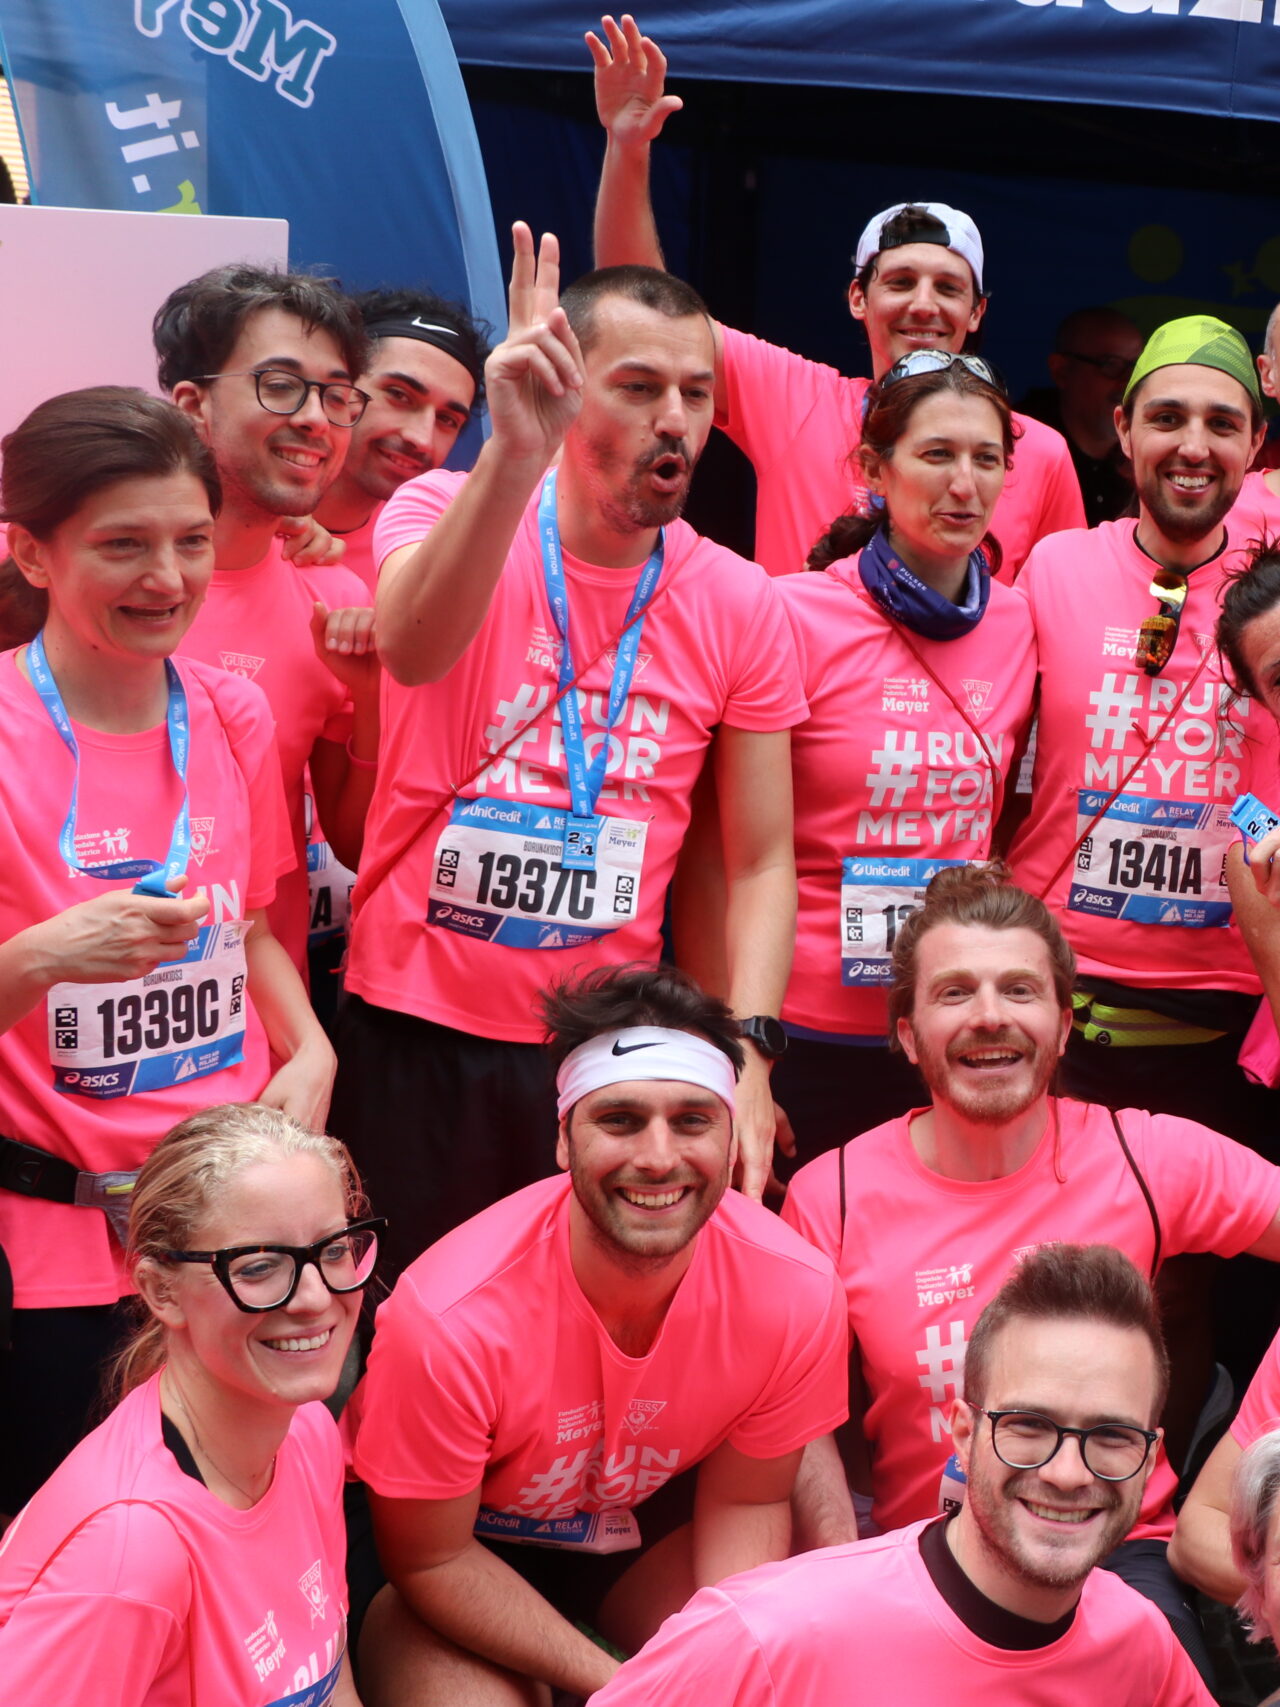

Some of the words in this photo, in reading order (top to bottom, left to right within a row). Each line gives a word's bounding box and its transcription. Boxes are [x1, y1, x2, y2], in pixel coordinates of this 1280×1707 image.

[639, 567, 656, 600] EDITION
[1102, 643, 1137, 660] Mey
[224, 655, 259, 670] GUESS
[882, 697, 930, 715] Meyer
[1148, 716, 1246, 758] FOR
[1084, 752, 1241, 798] MEYER
[470, 805, 522, 824] UniCredit
[1098, 797, 1141, 815] UiCredit
[1169, 806, 1196, 817] RELAY
[856, 809, 992, 846] MEYER
[864, 864, 911, 878] UniCredit
[1109, 839, 1202, 895] 1341A
[476, 851, 598, 921] 1337C
[1086, 893, 1113, 907] asics
[451, 909, 486, 928] asics
[863, 964, 892, 976] asics
[97, 978, 219, 1059] 1339C
[80, 1072, 120, 1088] asics
[917, 1286, 975, 1308] Meyer
[628, 1401, 658, 1414] UESS
[556, 1421, 602, 1445] Meye
[478, 1510, 521, 1529] niCredit
[555, 1521, 583, 1529] RELAY
[605, 1526, 631, 1536] Meyer
[254, 1638, 286, 1683] Meyer
